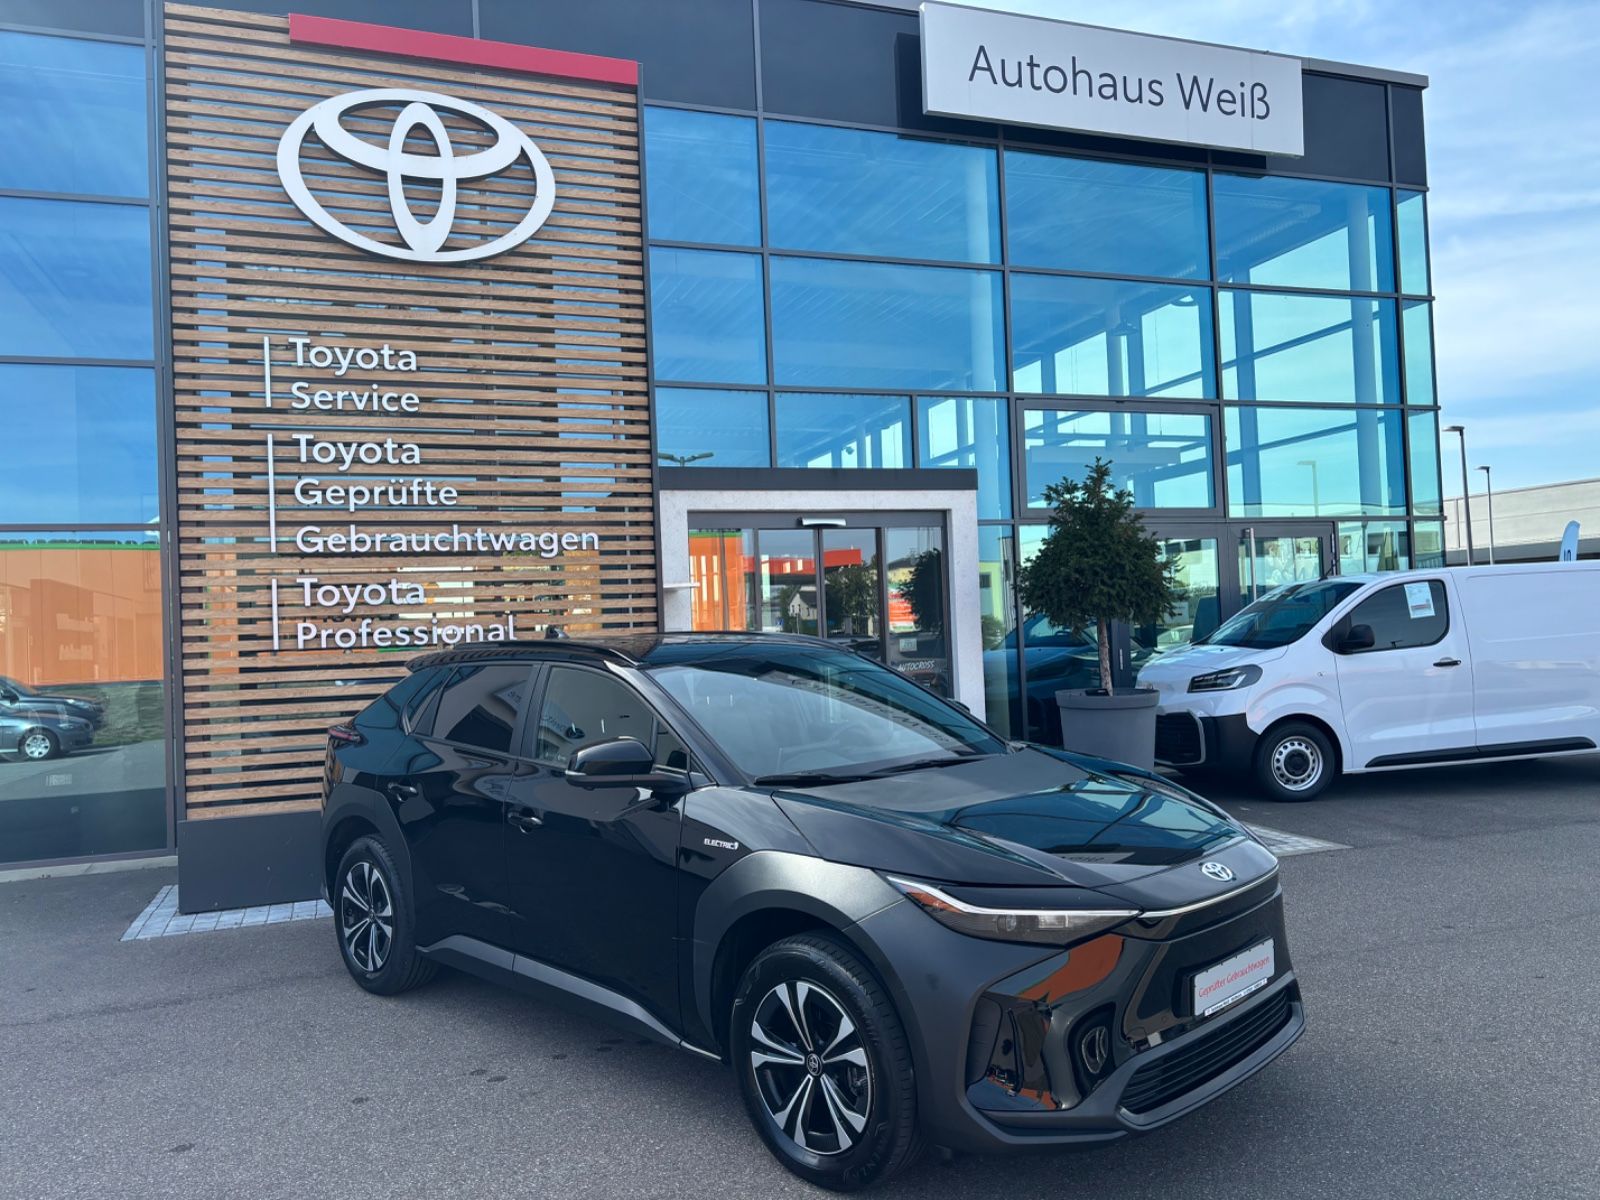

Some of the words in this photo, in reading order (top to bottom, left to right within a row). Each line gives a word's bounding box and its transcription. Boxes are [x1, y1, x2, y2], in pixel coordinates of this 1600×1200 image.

[968, 45, 1165, 107] Autohaus
[1175, 72, 1271, 120] Weiß
[288, 336, 418, 376] Toyota
[290, 381, 420, 412] Service
[292, 434, 421, 471] Toyota
[294, 478, 458, 512] Geprüfte
[296, 524, 600, 558] Gebrauchtwagen
[296, 577, 426, 614] Toyota
[297, 615, 518, 649] Professional
[704, 838, 735, 850] ELECTRIC
